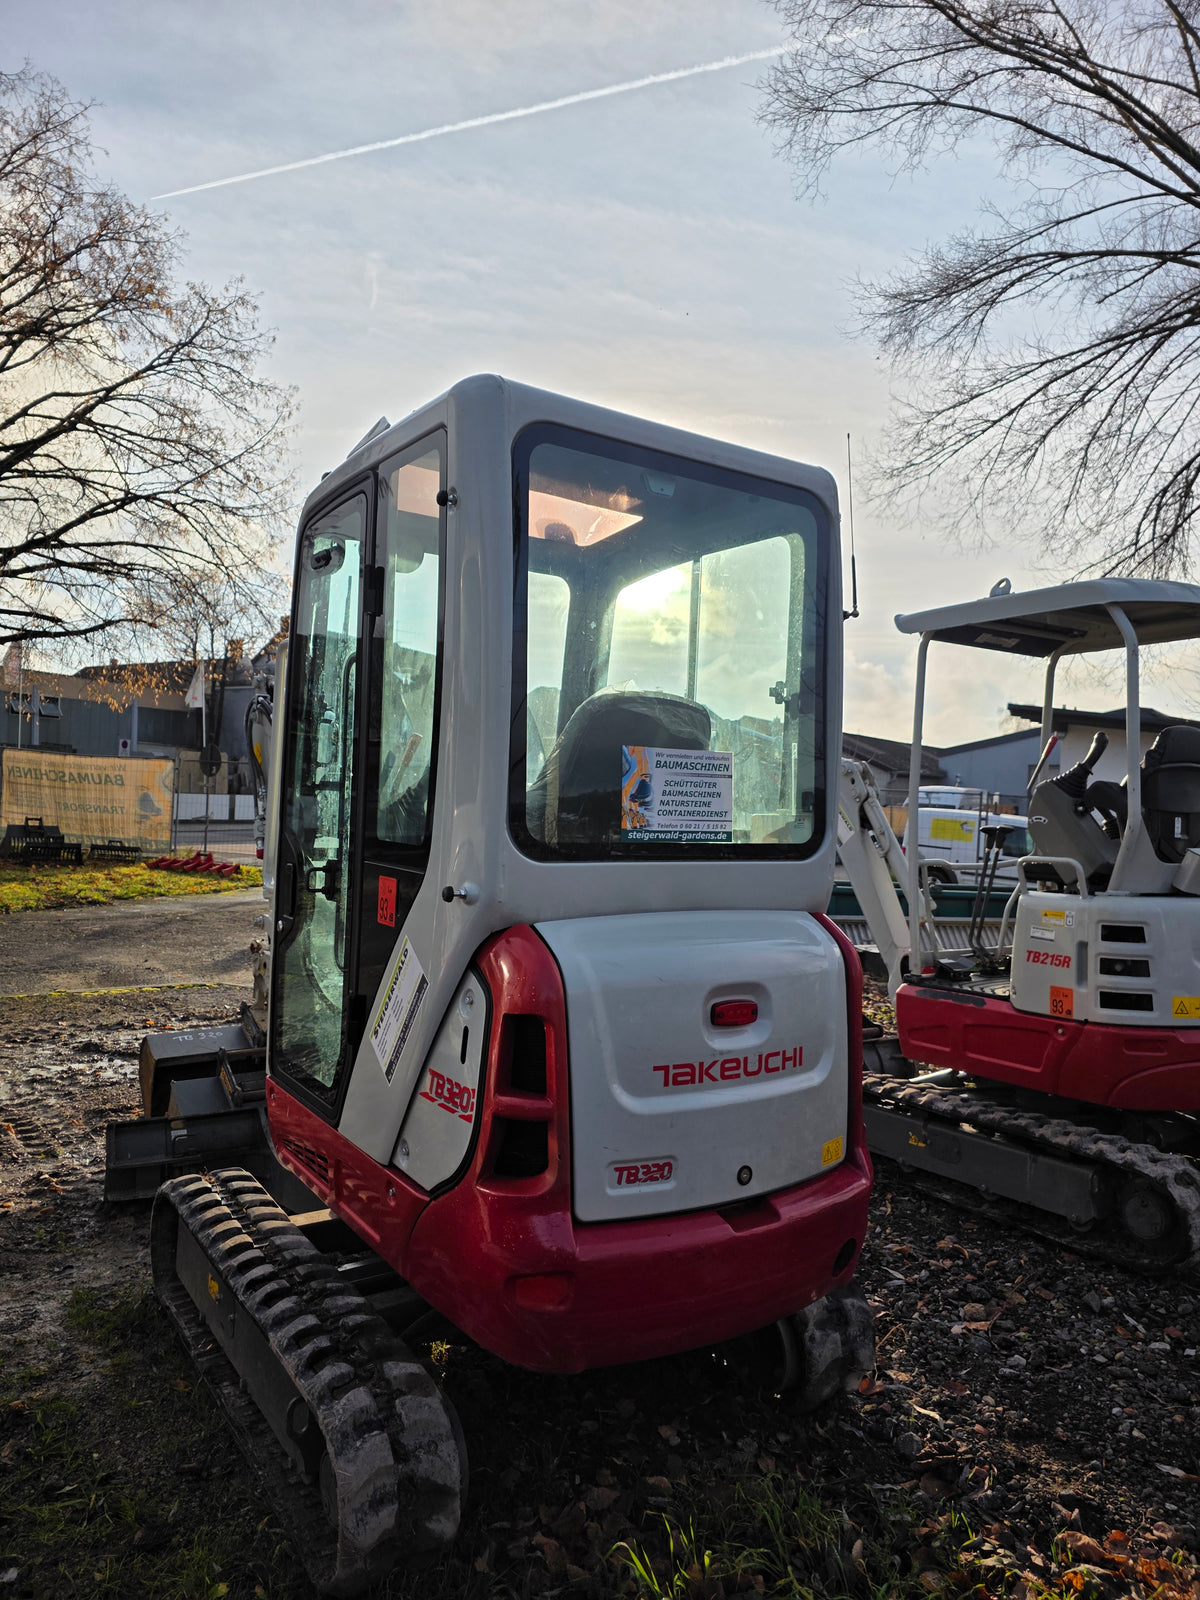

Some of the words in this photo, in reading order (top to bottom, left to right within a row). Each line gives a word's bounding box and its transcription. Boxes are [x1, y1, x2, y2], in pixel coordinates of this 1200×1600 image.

[655, 760, 730, 772] BAUMASCHINEN
[664, 779, 717, 789] SCHÜTTGÜTER
[662, 789, 722, 799] BAUMASCHINEN
[659, 799, 712, 808] NATURSTEINE
[657, 809, 728, 818] CONTAINERDIENST
[628, 831, 727, 840] steigerwald-gardens.de
[380, 897, 388, 920] 93
[1026, 950, 1072, 968] TB215R
[374, 948, 408, 1040] STEIGERWALD
[1052, 999, 1064, 1014] 93
[428, 1067, 472, 1114] TB320
[613, 1161, 673, 1186] TB320
